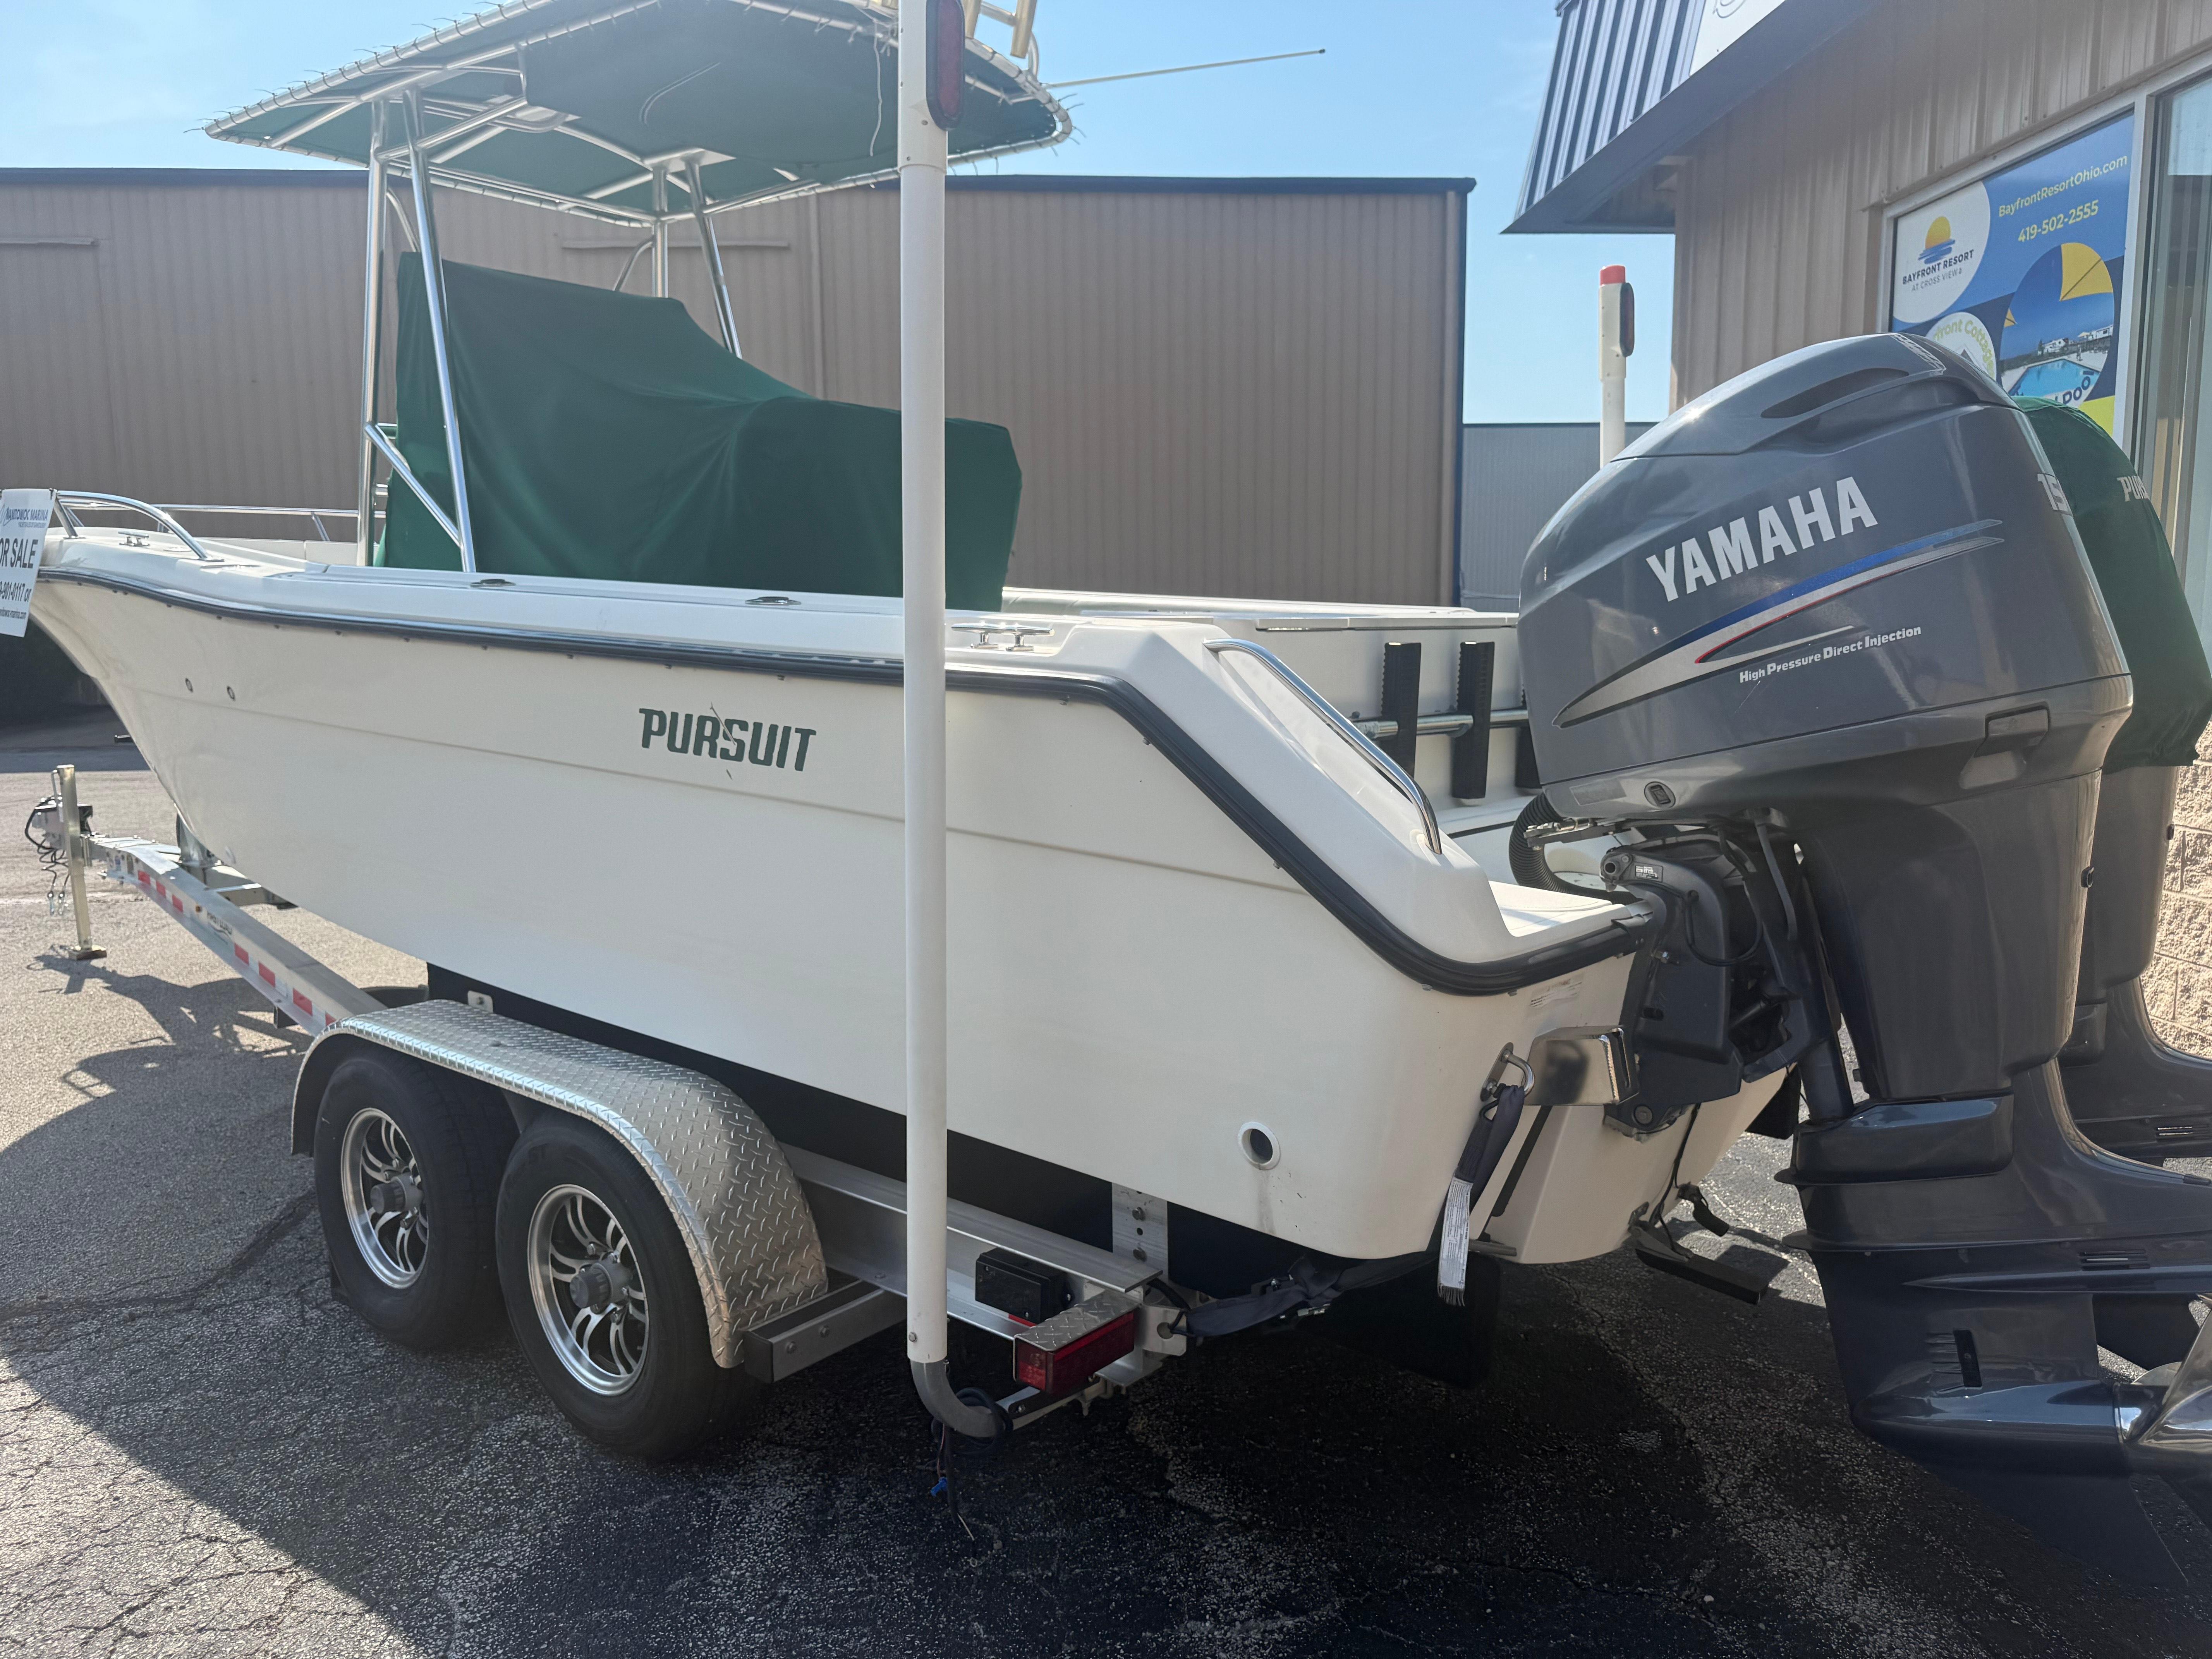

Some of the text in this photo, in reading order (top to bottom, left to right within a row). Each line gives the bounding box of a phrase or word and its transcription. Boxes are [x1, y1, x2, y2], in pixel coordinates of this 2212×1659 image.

[1999, 155, 2128, 217] BayfrontResortOhio.com
[2018, 199, 2099, 242] 419-502-2555
[1902, 249, 1974, 285] BAYFRONT RESORT
[1920, 275, 1941, 289] CROSS
[30, 509, 48, 521] MARINA
[10, 538, 38, 568] SALE
[1646, 476, 1878, 602] YAMAHA
[24, 588, 32, 602] or
[1739, 626, 1921, 683] High Pressure Direct Injection
[639, 708, 817, 771] PURSUIT
